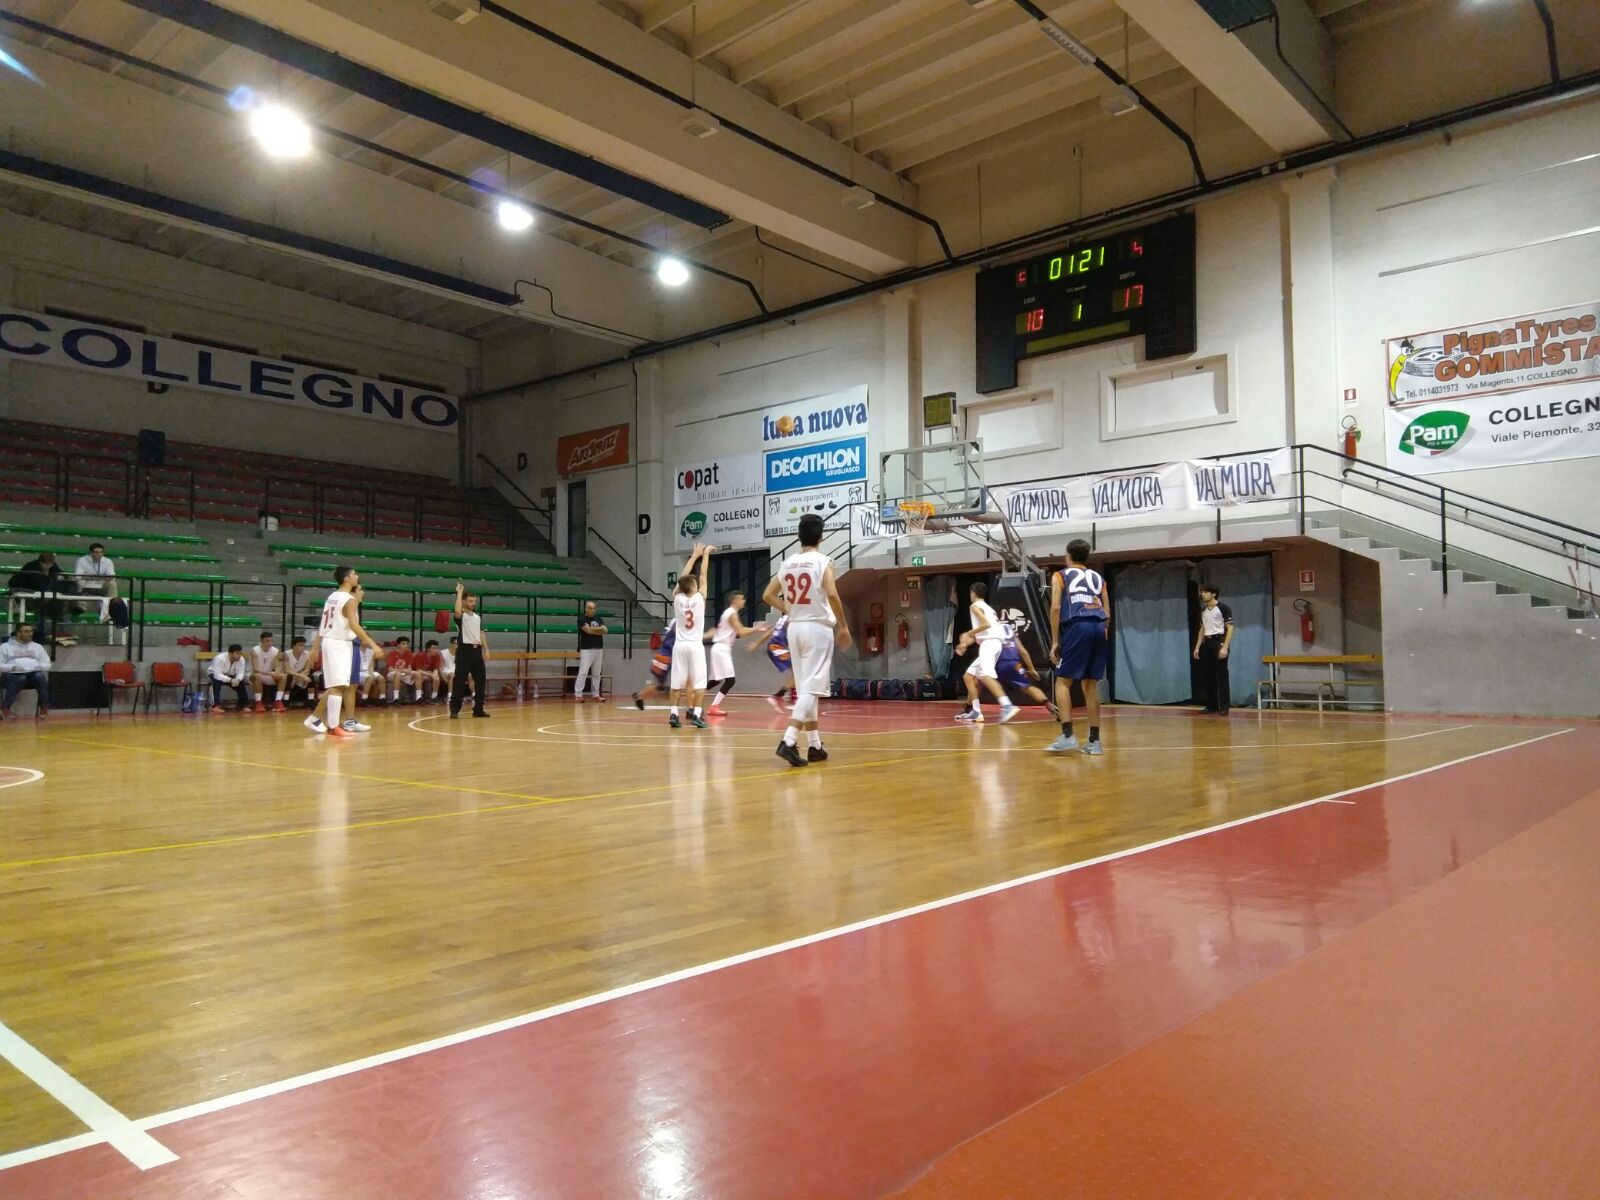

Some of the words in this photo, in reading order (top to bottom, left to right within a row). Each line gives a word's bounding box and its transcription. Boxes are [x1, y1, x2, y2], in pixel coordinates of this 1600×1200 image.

[1124, 284, 1144, 308] 17
[1027, 308, 1045, 331] 10
[1076, 303, 1083, 320] 1
[1442, 313, 1597, 356] PignaTyres
[0, 312, 458, 428] COLLEGNO
[1433, 334, 1600, 383] GOMMISTA
[1466, 382, 1479, 391] Via
[1526, 367, 1578, 381] COLLEGNO
[807, 402, 868, 434] nuova
[1410, 424, 1458, 443] Pam
[1491, 432, 1520, 443] Viale
[517, 452, 528, 471] D
[771, 446, 861, 479] DECATHLON
[825, 465, 861, 478] GRUGLIASCO
[1195, 460, 1276, 502] VALMORA
[1006, 489, 1070, 524] VALMORA
[1092, 476, 1164, 514] VALMORA
[638, 513, 651, 535] D
[684, 519, 703, 531] Pam
[713, 508, 760, 522] COLLEGNO
[784, 572, 812, 605] 32
[1064, 567, 1103, 595] 20
[684, 609, 695, 630] 3
